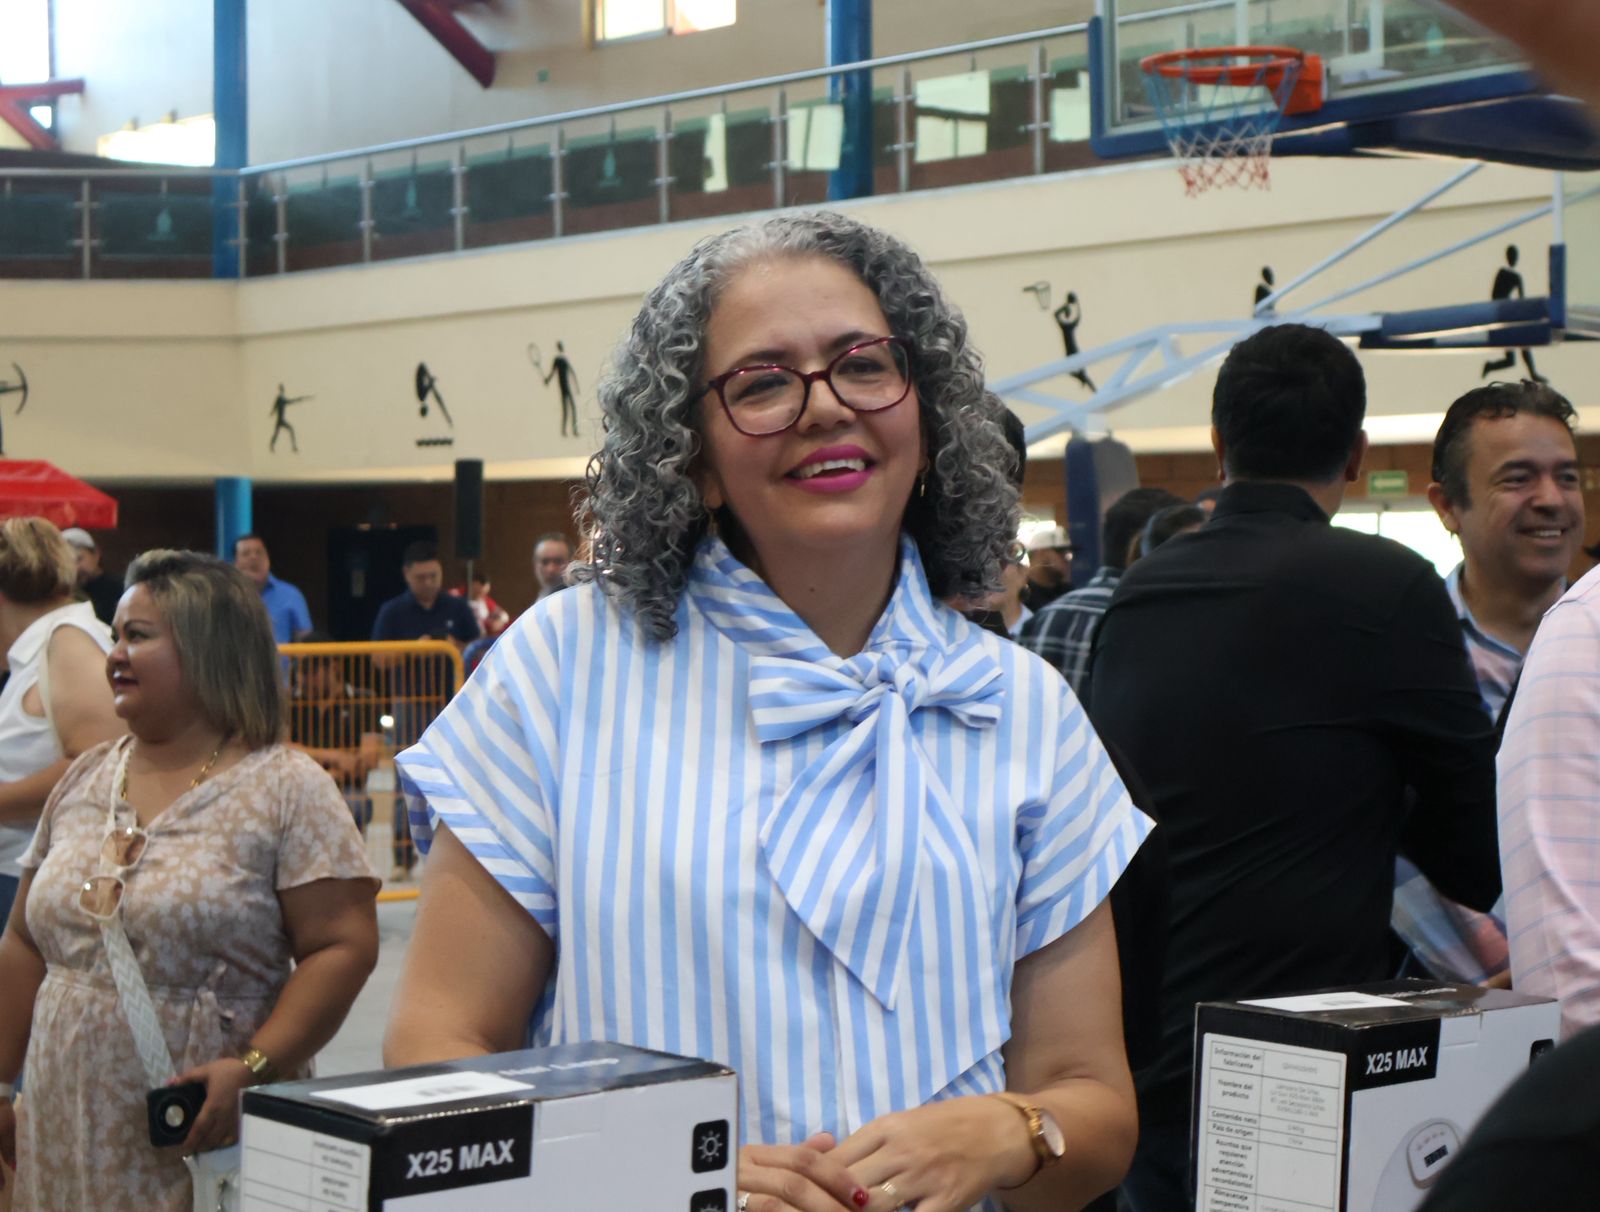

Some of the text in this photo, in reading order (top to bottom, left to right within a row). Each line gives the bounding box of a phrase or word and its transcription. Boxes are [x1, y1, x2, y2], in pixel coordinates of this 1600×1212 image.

[1365, 1046, 1428, 1075] X25 MAX
[406, 1138, 515, 1179] X25 MAX
